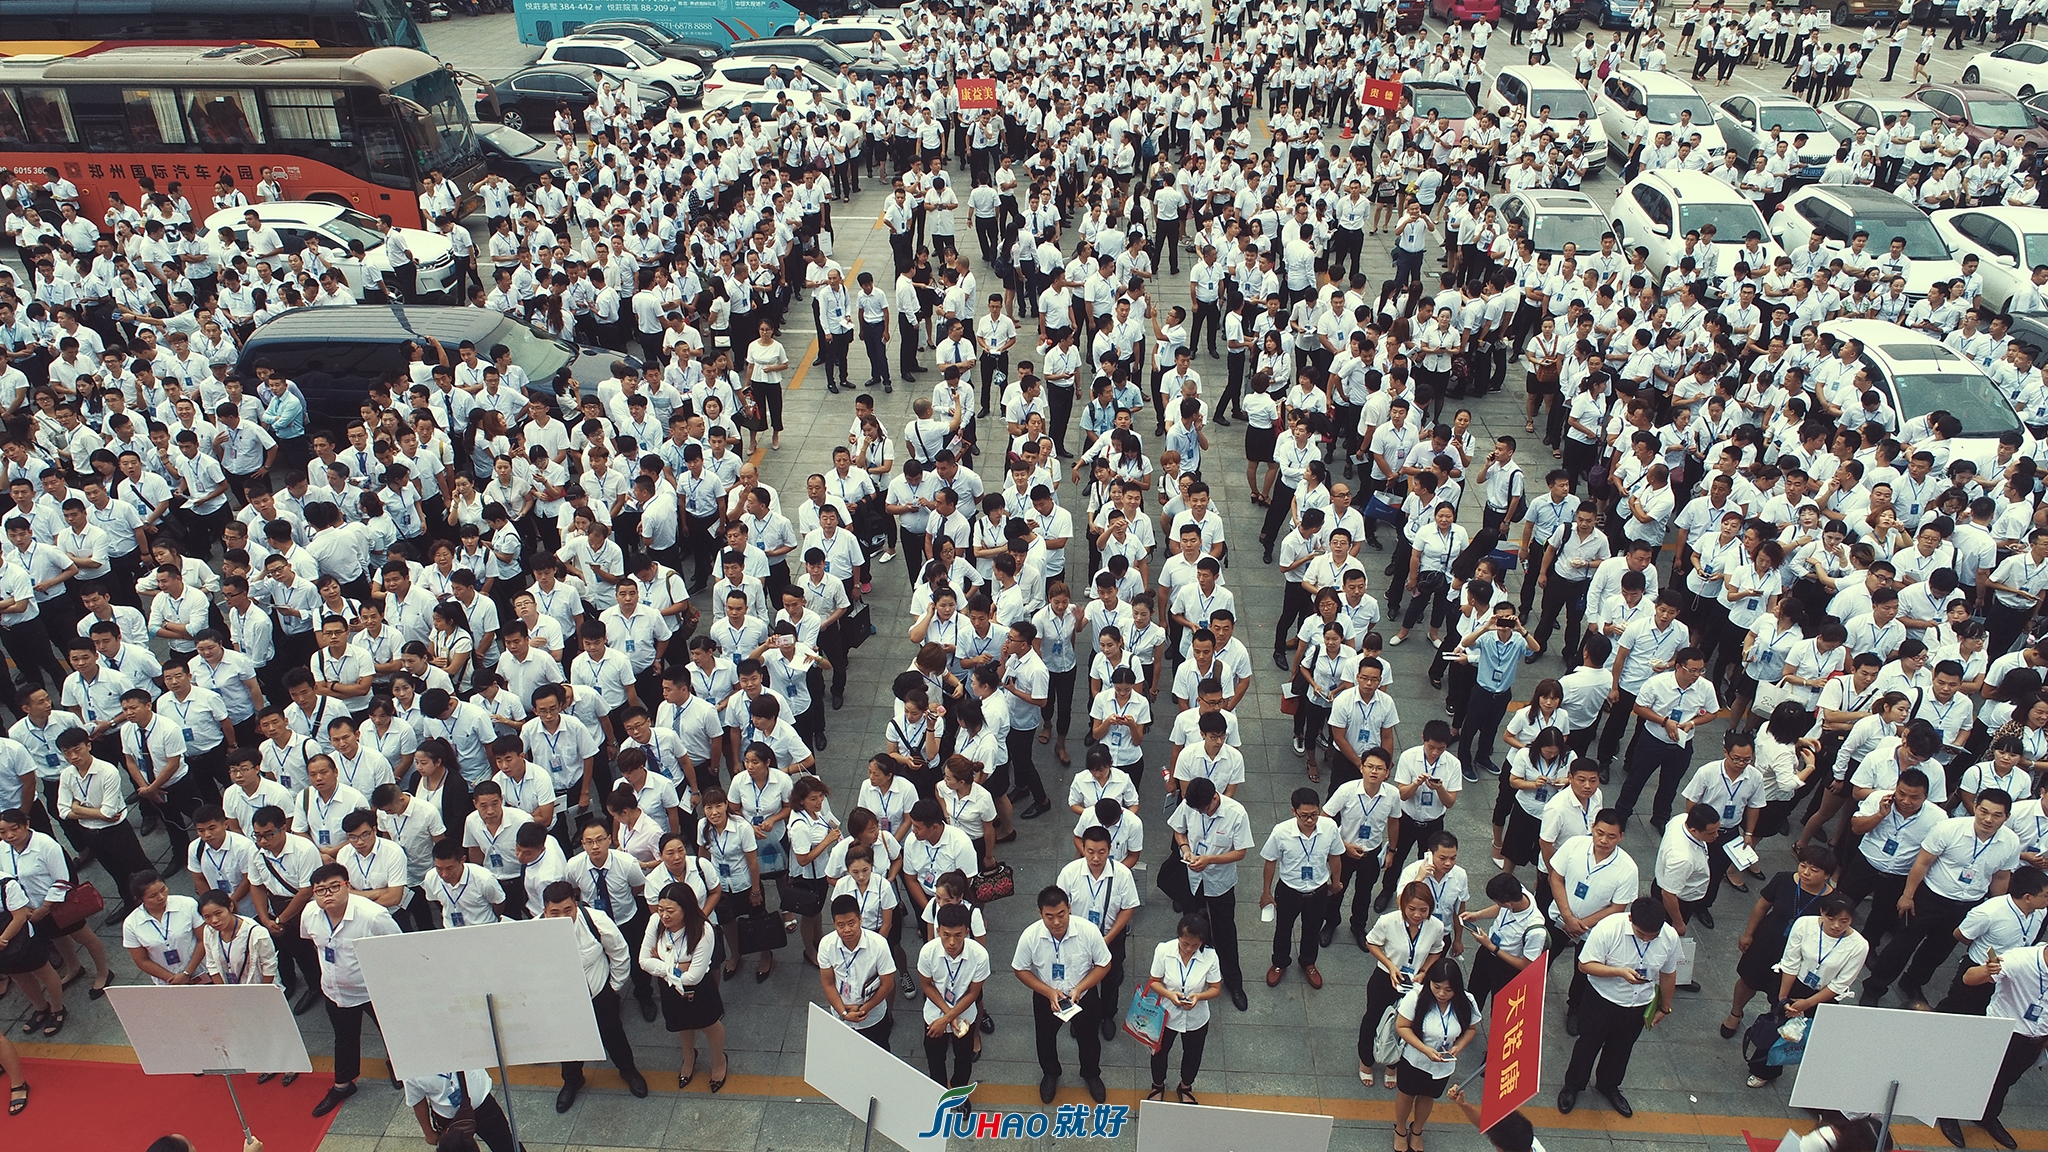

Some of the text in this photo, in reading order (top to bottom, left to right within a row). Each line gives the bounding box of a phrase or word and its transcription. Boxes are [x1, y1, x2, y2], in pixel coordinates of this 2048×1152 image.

[961, 86, 994, 101] 康益美
[13, 166, 32, 175] 6015
[88, 163, 255, 180] 郑州国际汽车公园
[1499, 984, 1527, 1100] 天诺康
